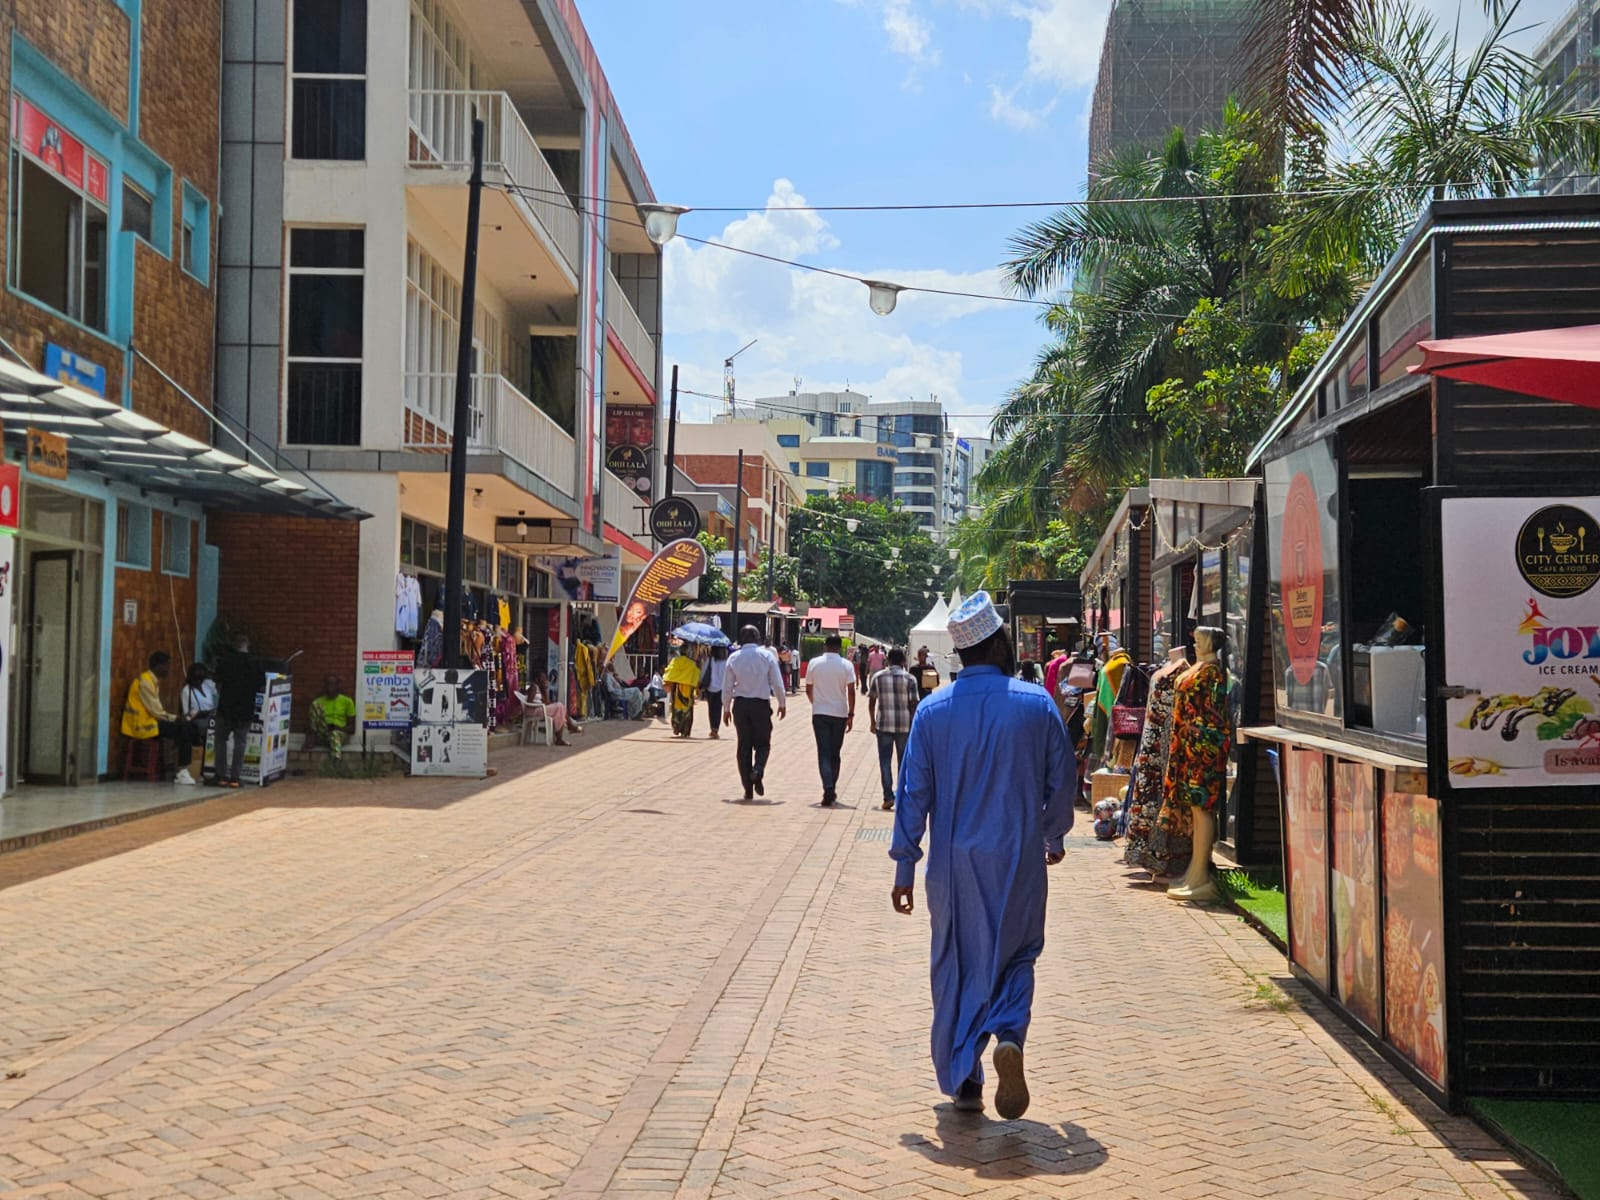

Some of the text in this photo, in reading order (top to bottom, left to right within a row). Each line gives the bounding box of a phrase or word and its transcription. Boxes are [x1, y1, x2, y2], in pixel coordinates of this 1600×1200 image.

[1525, 554, 1599, 565] CITY CENTER
[1522, 626, 1600, 665] JOY
[1539, 665, 1599, 675] ICE CREAM
